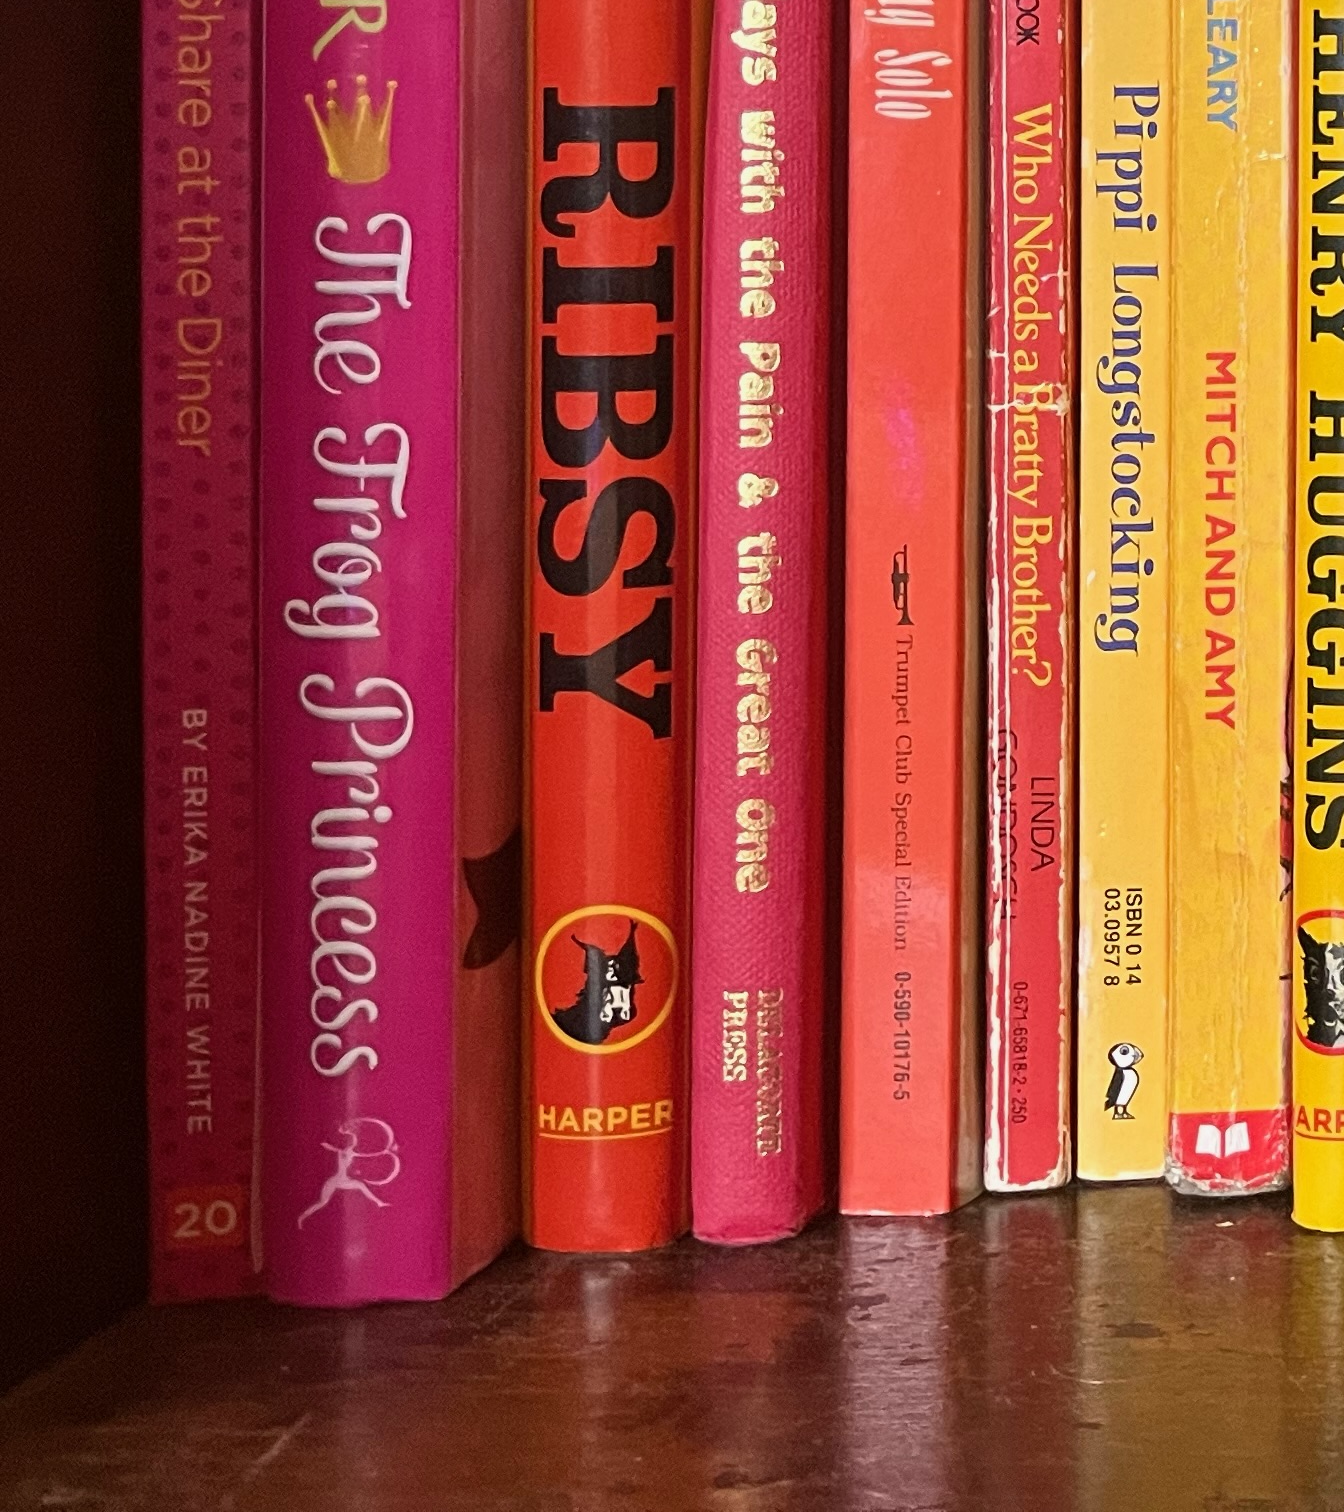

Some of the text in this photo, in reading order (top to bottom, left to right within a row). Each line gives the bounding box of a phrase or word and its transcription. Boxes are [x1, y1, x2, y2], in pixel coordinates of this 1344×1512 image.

[873, 49, 953, 119] Solo
[177, 146, 220, 195] at
[177, 216, 222, 296] the
[177, 318, 222, 455] Diner
[538, 87, 676, 739] RIBSY
[1093, 85, 1160, 655] Pippi Longstocking
[1205, 353, 1236, 730] MITCH AND AMY
[284, 213, 414, 1077] The Frog Princess
[1030, 777, 1055, 871] LINDA
[182, 709, 212, 1134] BY ERIKA NADINE WHITE
[723, 991, 746, 1082] PRESS
[538, 1103, 672, 1129] HARPER
[175, 1201, 237, 1238] 20
